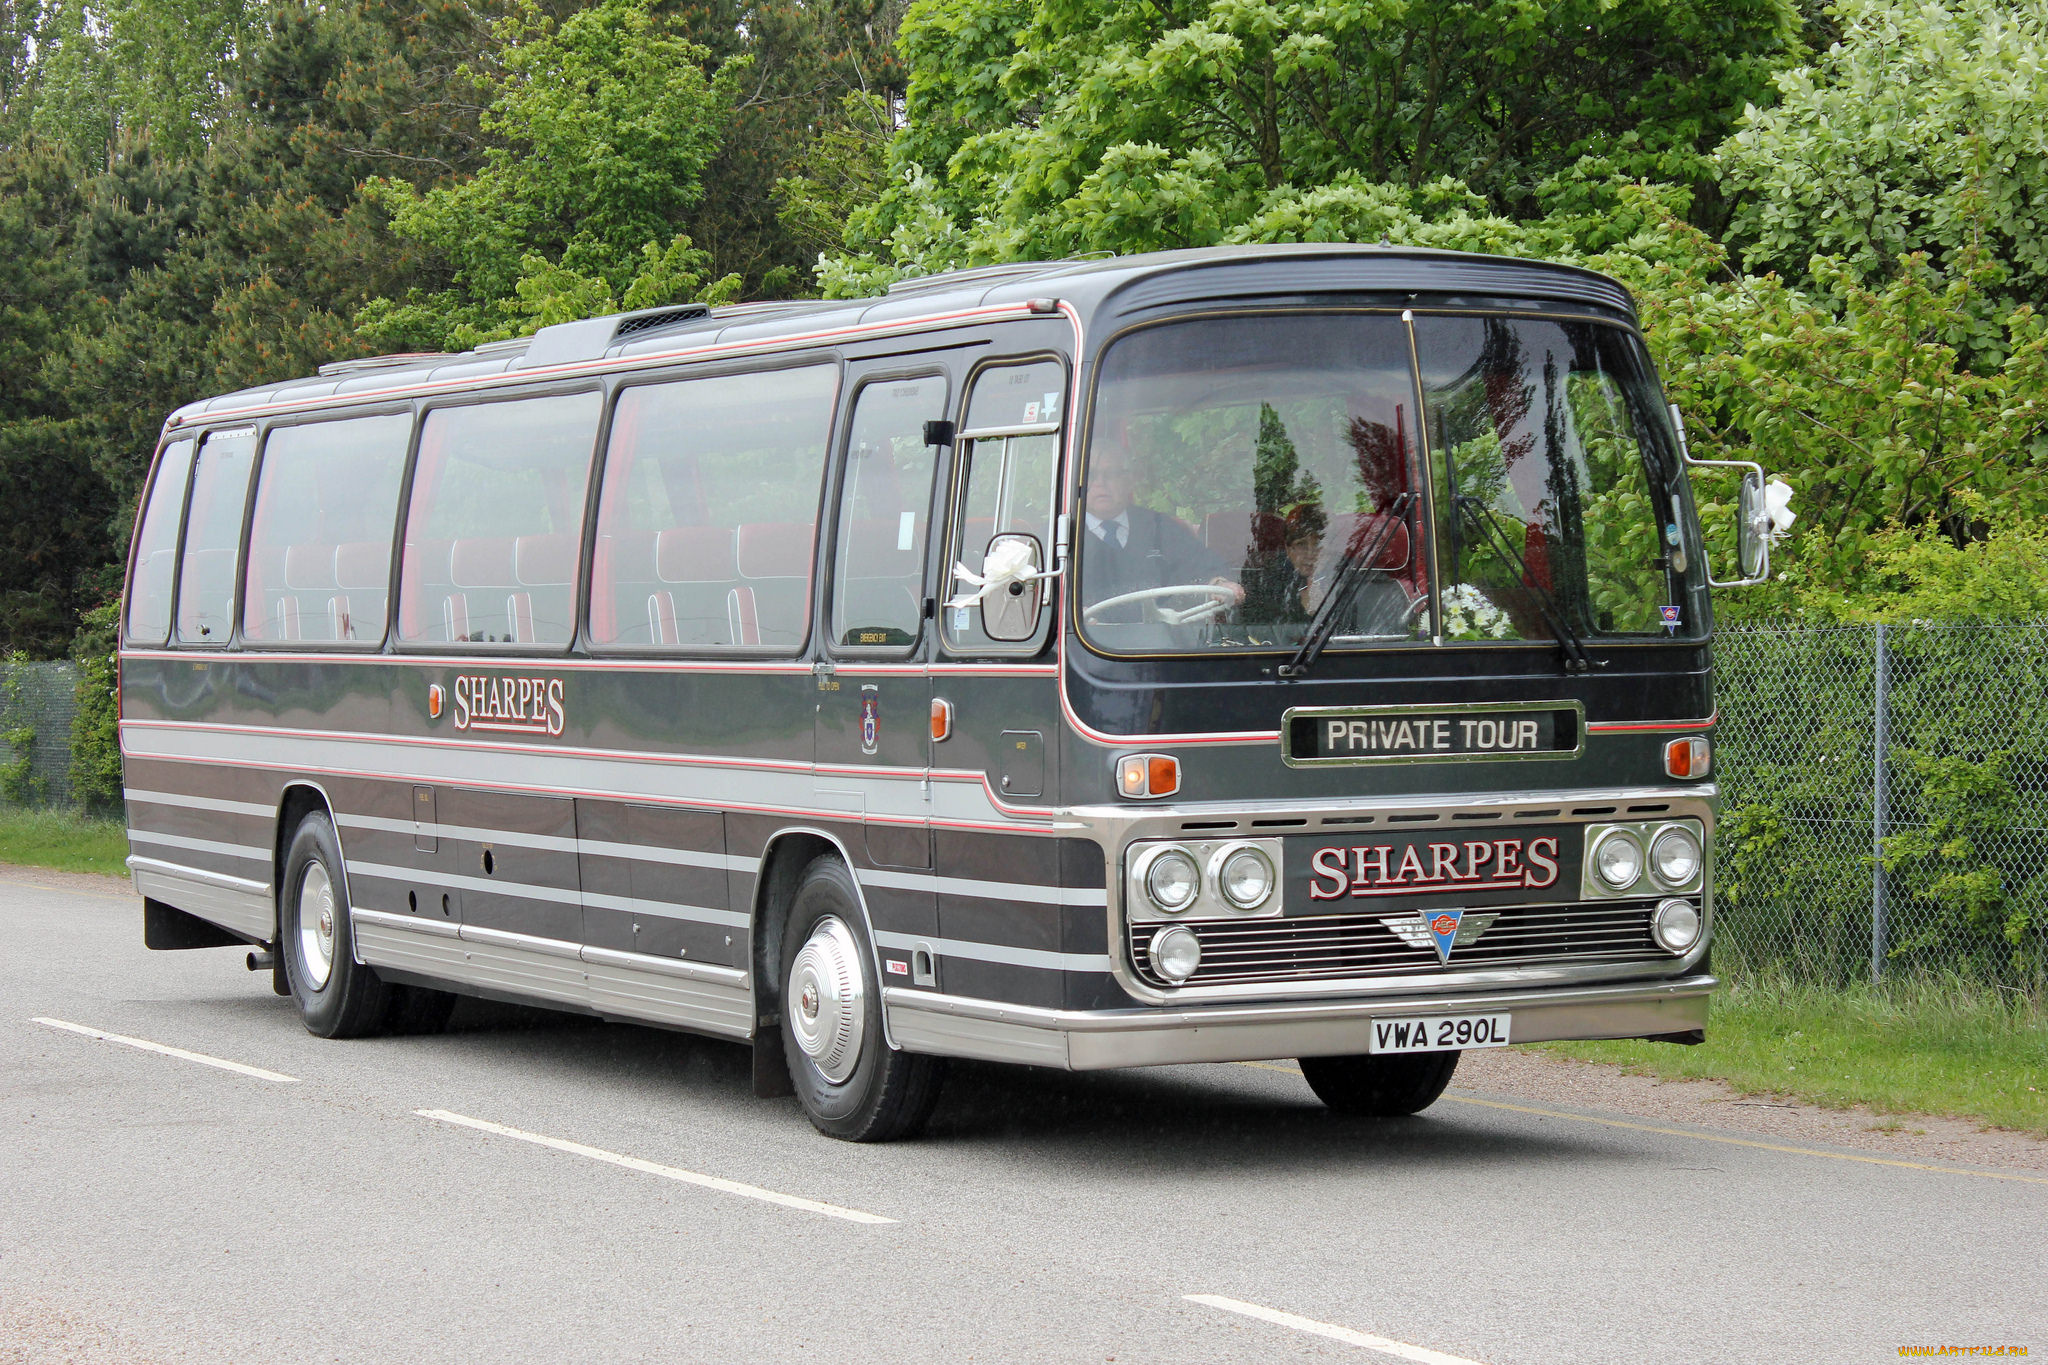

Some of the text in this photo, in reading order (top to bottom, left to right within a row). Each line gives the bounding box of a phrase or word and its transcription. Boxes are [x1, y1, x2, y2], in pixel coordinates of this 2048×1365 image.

[454, 674, 565, 737] SHARPES
[1327, 720, 1538, 750] PRIVATE TOUR
[1309, 836, 1559, 900] SHARPES
[1376, 1018, 1506, 1049] VWA 290L
